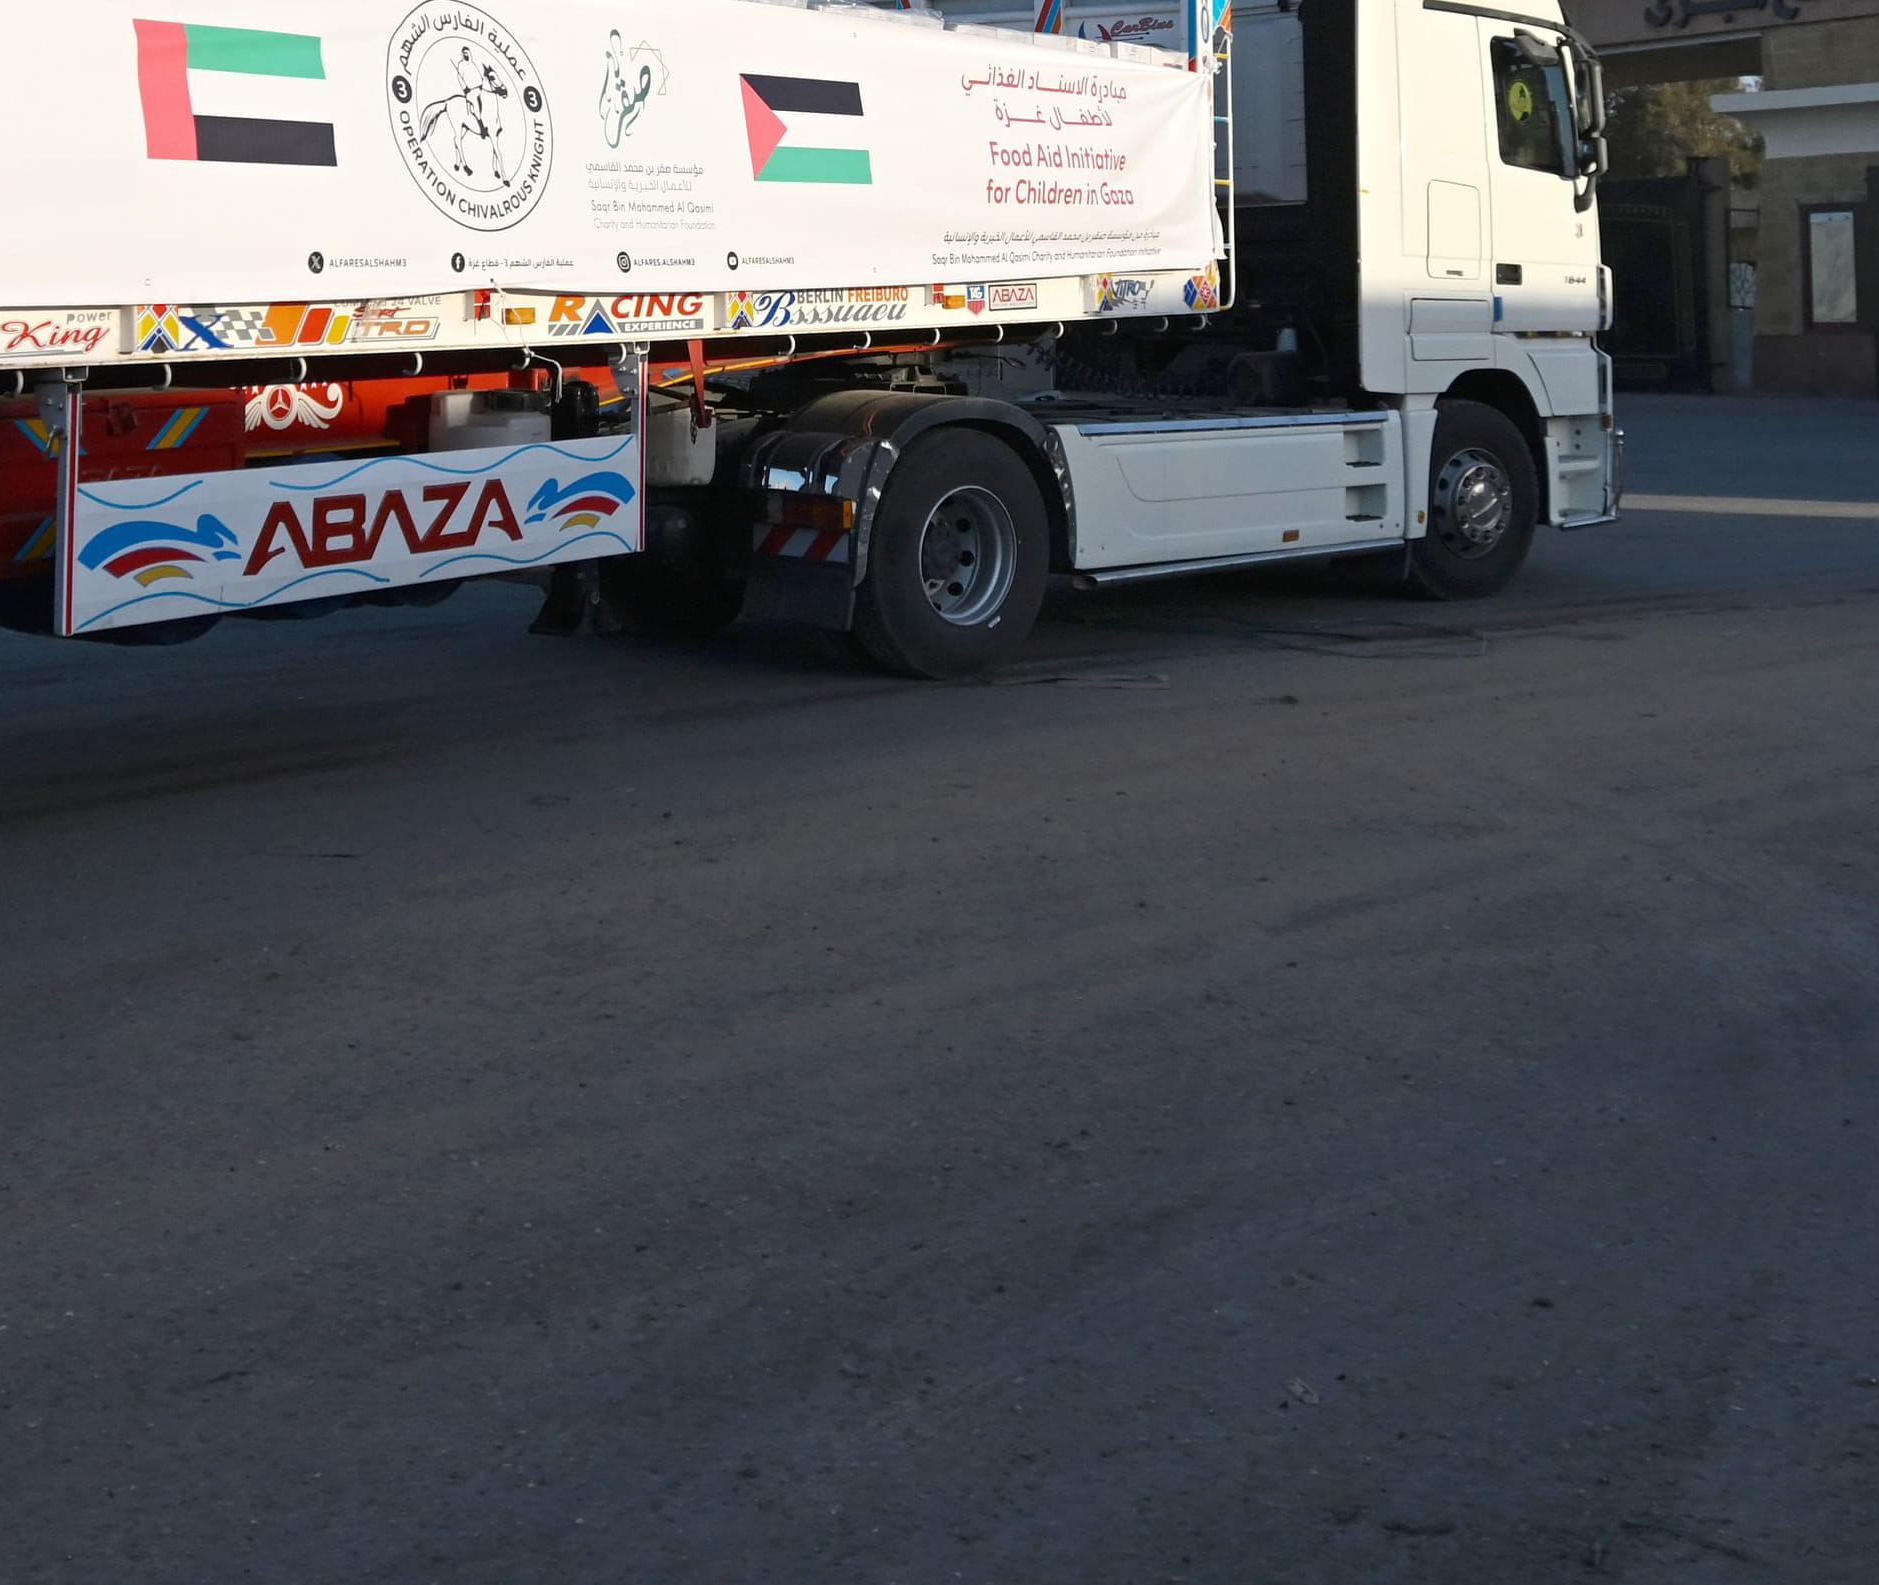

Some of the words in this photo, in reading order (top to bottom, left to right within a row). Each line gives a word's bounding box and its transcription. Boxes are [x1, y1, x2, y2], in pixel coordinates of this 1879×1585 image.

[434, 11, 484, 35] الفارس
[399, 13, 430, 75] الشهم
[488, 29, 527, 81] عملية
[397, 80, 407, 99] 3
[962, 65, 1024, 96] الغذائي
[1092, 76, 1127, 104] مبادرة
[528, 91, 538, 108] 3
[994, 99, 1046, 127] غزة
[1050, 106, 1112, 130] لأطفال
[400, 110, 455, 205] OPERATION
[459, 182, 532, 219] CHIVALROUS
[530, 119, 544, 183] KNIGHT
[989, 141, 1031, 166] Food
[1038, 144, 1062, 167] Aid
[1065, 145, 1126, 171] Initiative
[987, 179, 1011, 204] for
[1016, 179, 1082, 205] Children
[1087, 183, 1098, 205] in
[1100, 182, 1134, 205] Gaza
[591, 200, 610, 214] Saqr
[613, 200, 625, 212] Bin
[629, 202, 675, 213] Mohammed
[677, 202, 685, 213] Al
[687, 202, 714, 213] Qasimi
[932, 254, 947, 266] Saqr
[950, 253, 961, 264] Bin
[962, 252, 1000, 264] Mohammed
[1010, 252, 1030, 263] Qasimi
[1032, 251, 1052, 263] Charity
[1054, 251, 1065, 260] and
[408, 296, 441, 305] VALVE
[797, 288, 843, 303] BERLIN
[993, 288, 1034, 302] ABAZA
[1, 319, 110, 352] King
[625, 320, 696, 331] EXPERIENCE
[244, 478, 524, 575] ABAZA
